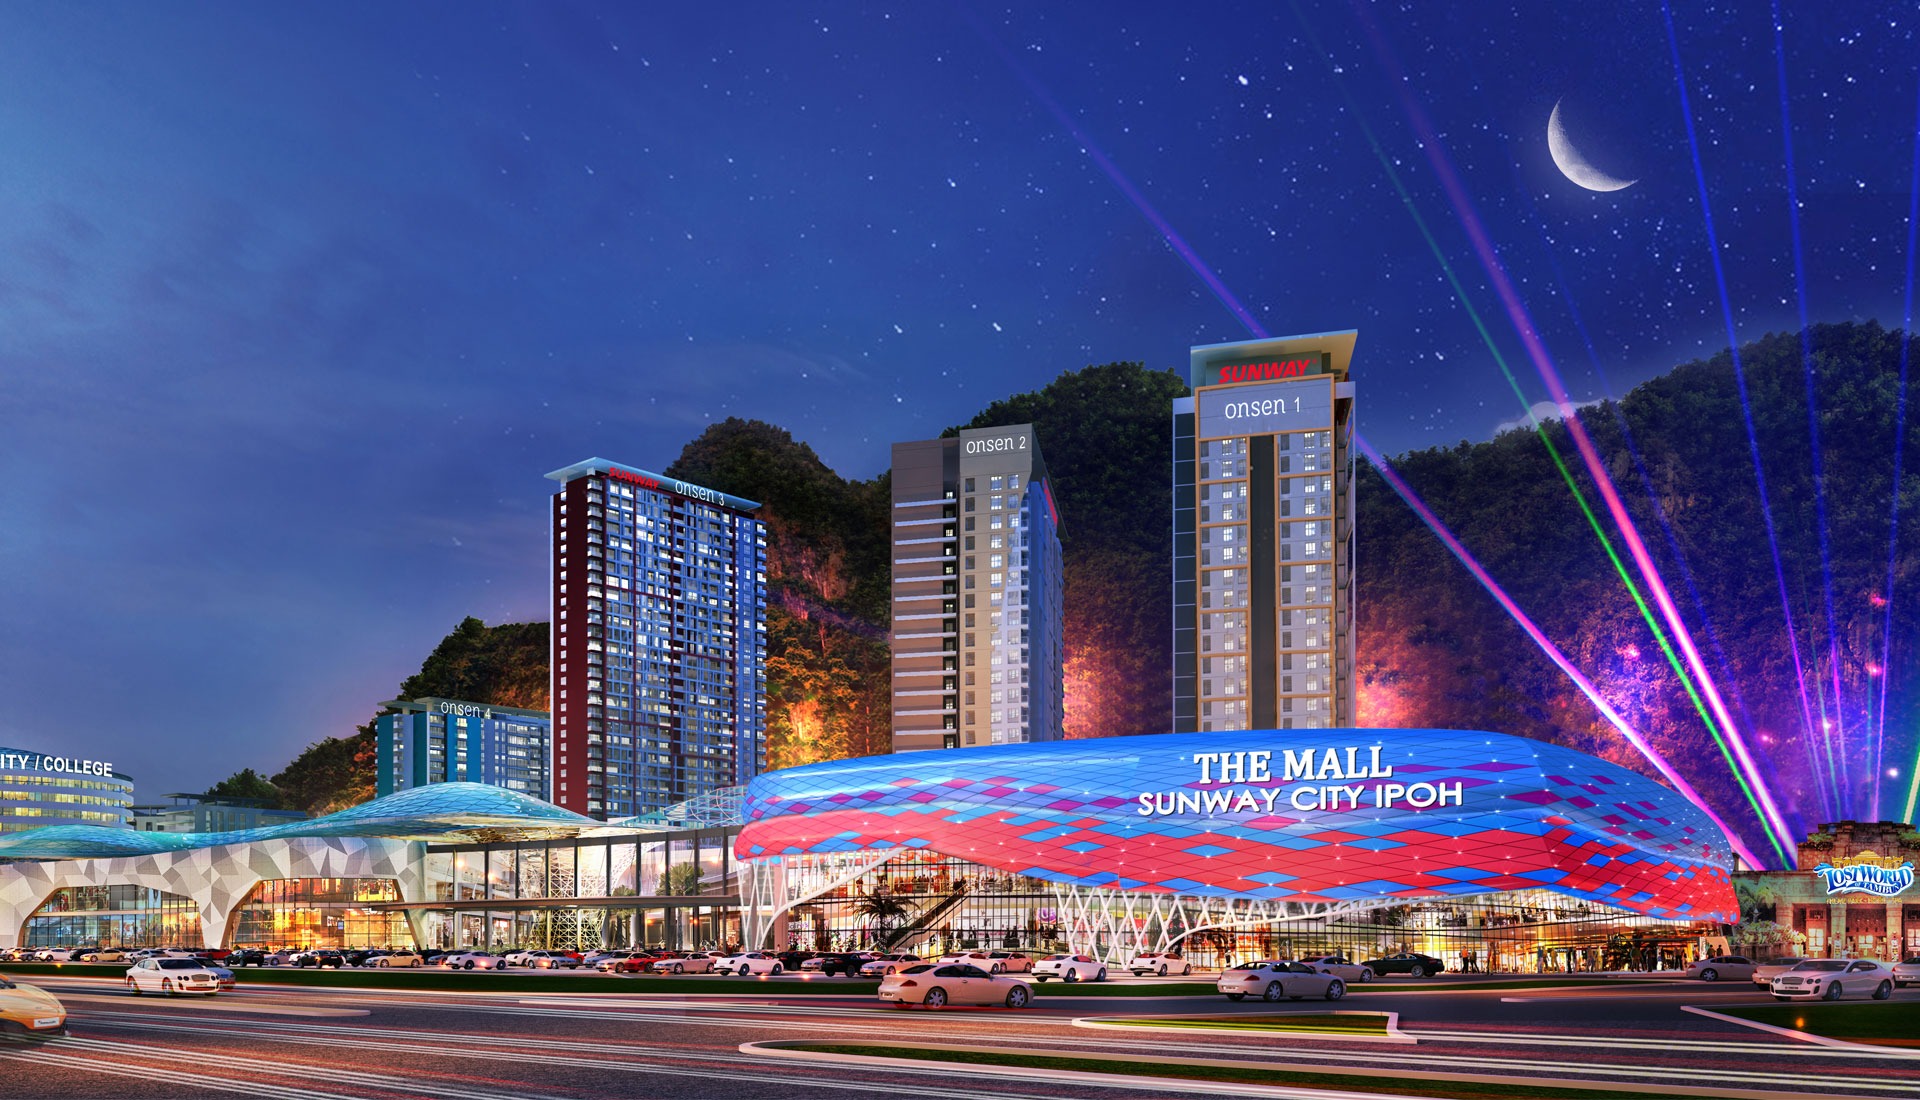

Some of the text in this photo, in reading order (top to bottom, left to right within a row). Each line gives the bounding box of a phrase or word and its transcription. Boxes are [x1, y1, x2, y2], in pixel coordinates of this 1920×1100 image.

[1218, 359, 1311, 384] SUNWAY
[1225, 396, 1300, 419] onsen 1
[966, 436, 1026, 454] onsen 2
[608, 467, 660, 489] SUNWAY
[675, 481, 725, 506] onsen 3
[441, 701, 491, 719] onsen 4
[43, 756, 113, 777] COLLEGE
[1193, 746, 1392, 784] THE MALL
[1137, 782, 1463, 816] SUNWAY CITY IPOH
